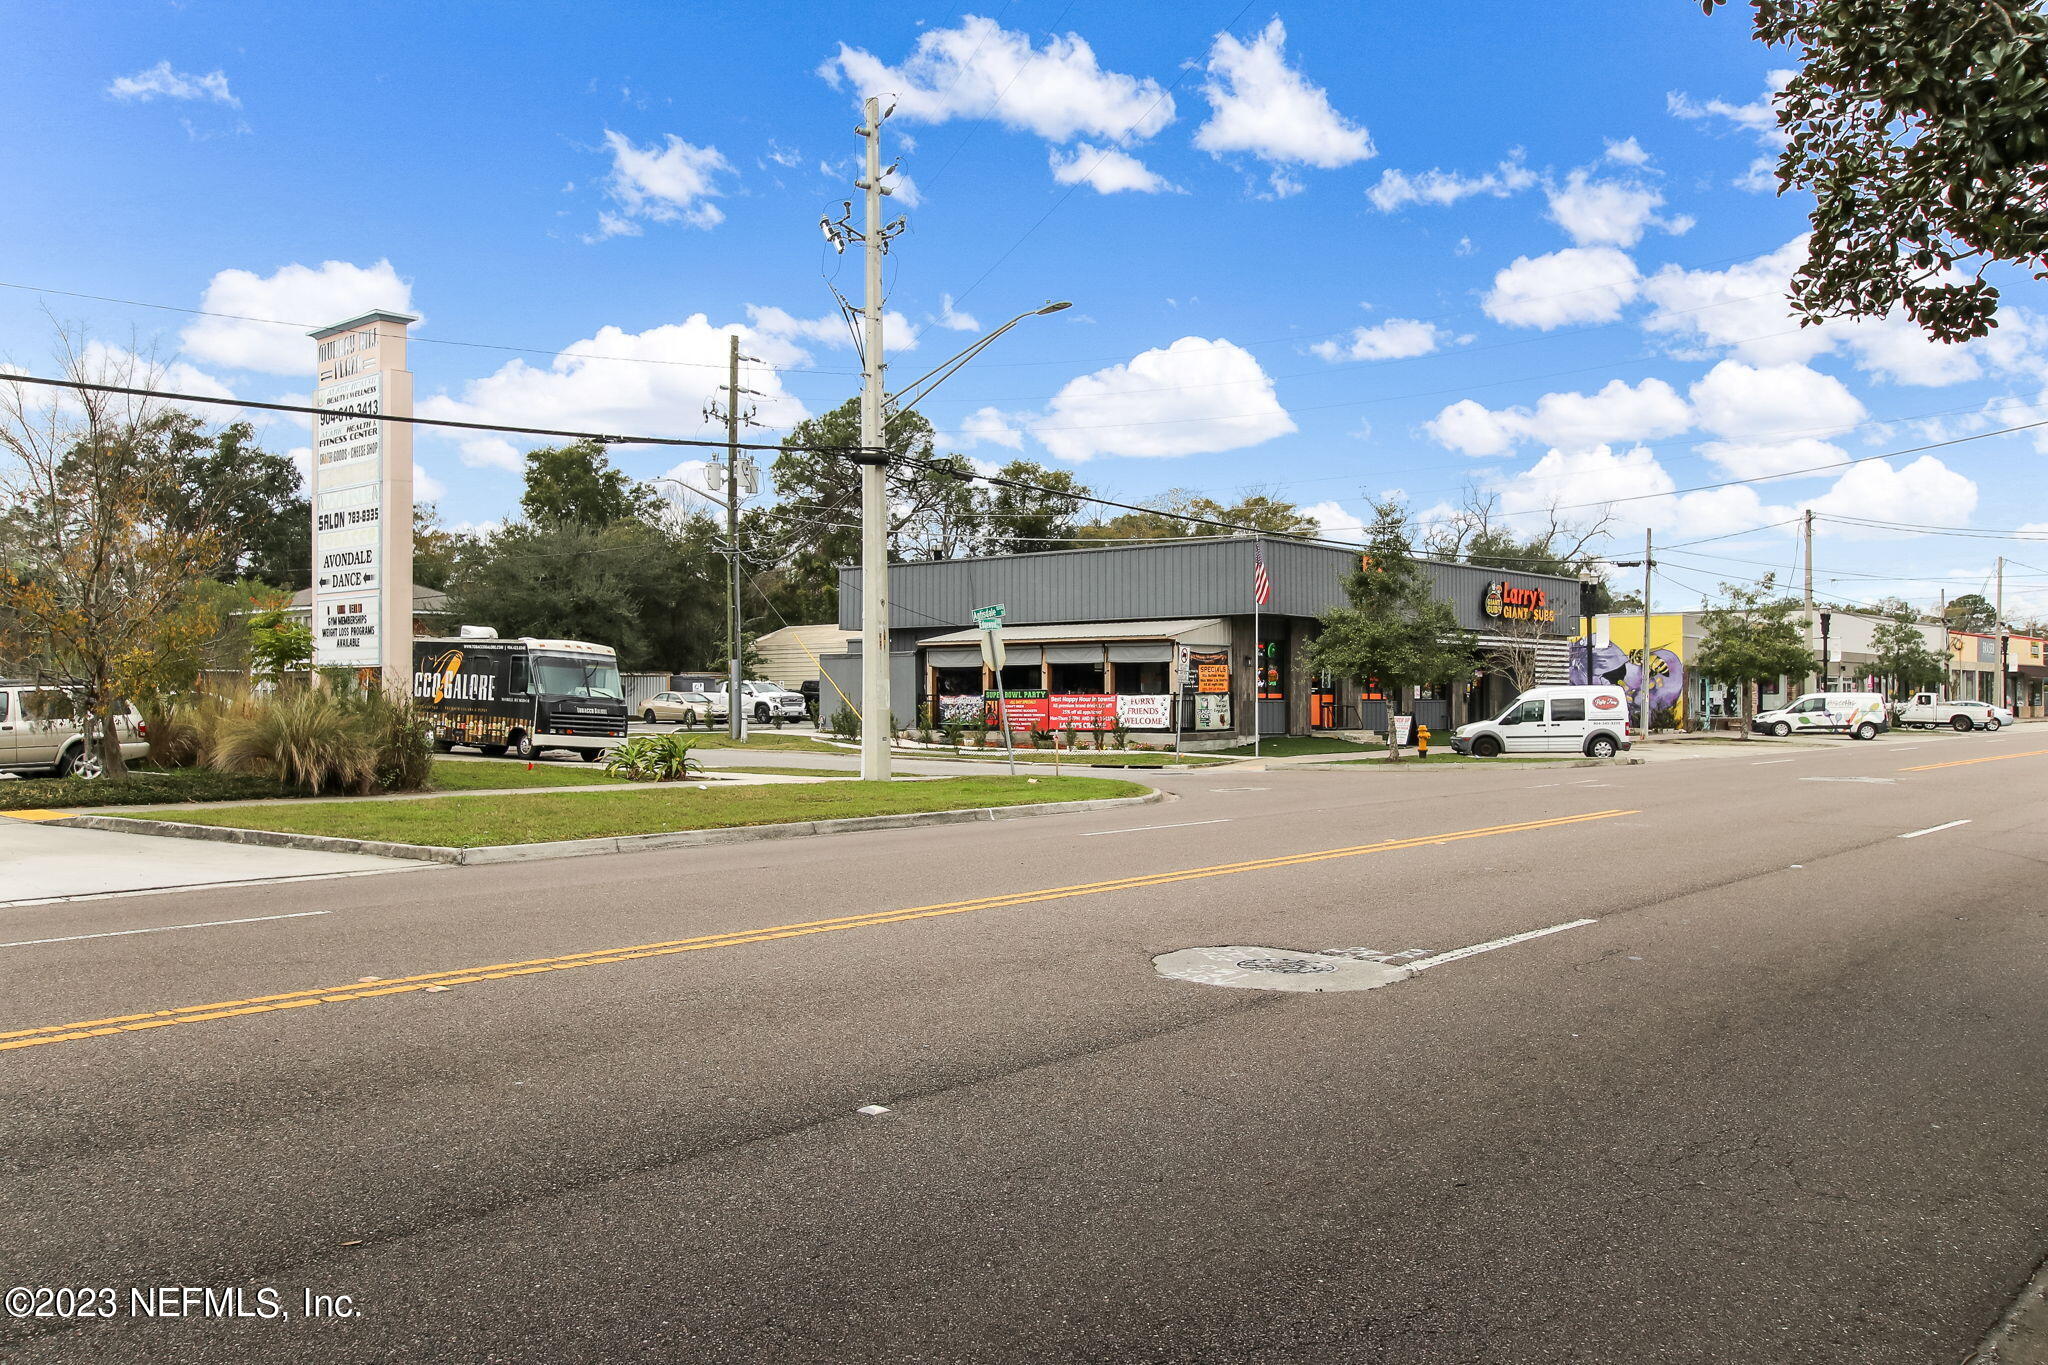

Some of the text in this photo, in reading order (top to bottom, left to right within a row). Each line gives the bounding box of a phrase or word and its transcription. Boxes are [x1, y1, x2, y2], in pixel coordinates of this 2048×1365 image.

[350, 386, 376, 398] WELLNESS
[347, 420, 371, 433] HEALTH
[320, 428, 378, 447] FITNESS CENTER
[318, 512, 345, 531] SALON
[323, 549, 373, 569] AVONDALE
[332, 572, 362, 588] DANCE
[1503, 581, 1546, 611] Larry's
[1503, 605, 1556, 622] GIANT SUBS
[351, 625, 375, 636] PROGRAMS
[337, 638, 360, 648] AVAILABLE
[443, 670, 496, 702] GALORE
[1131, 697, 1156, 705] FURRY
[1127, 707, 1159, 715] FRIENDS
[1123, 717, 1163, 725] WELCOME
